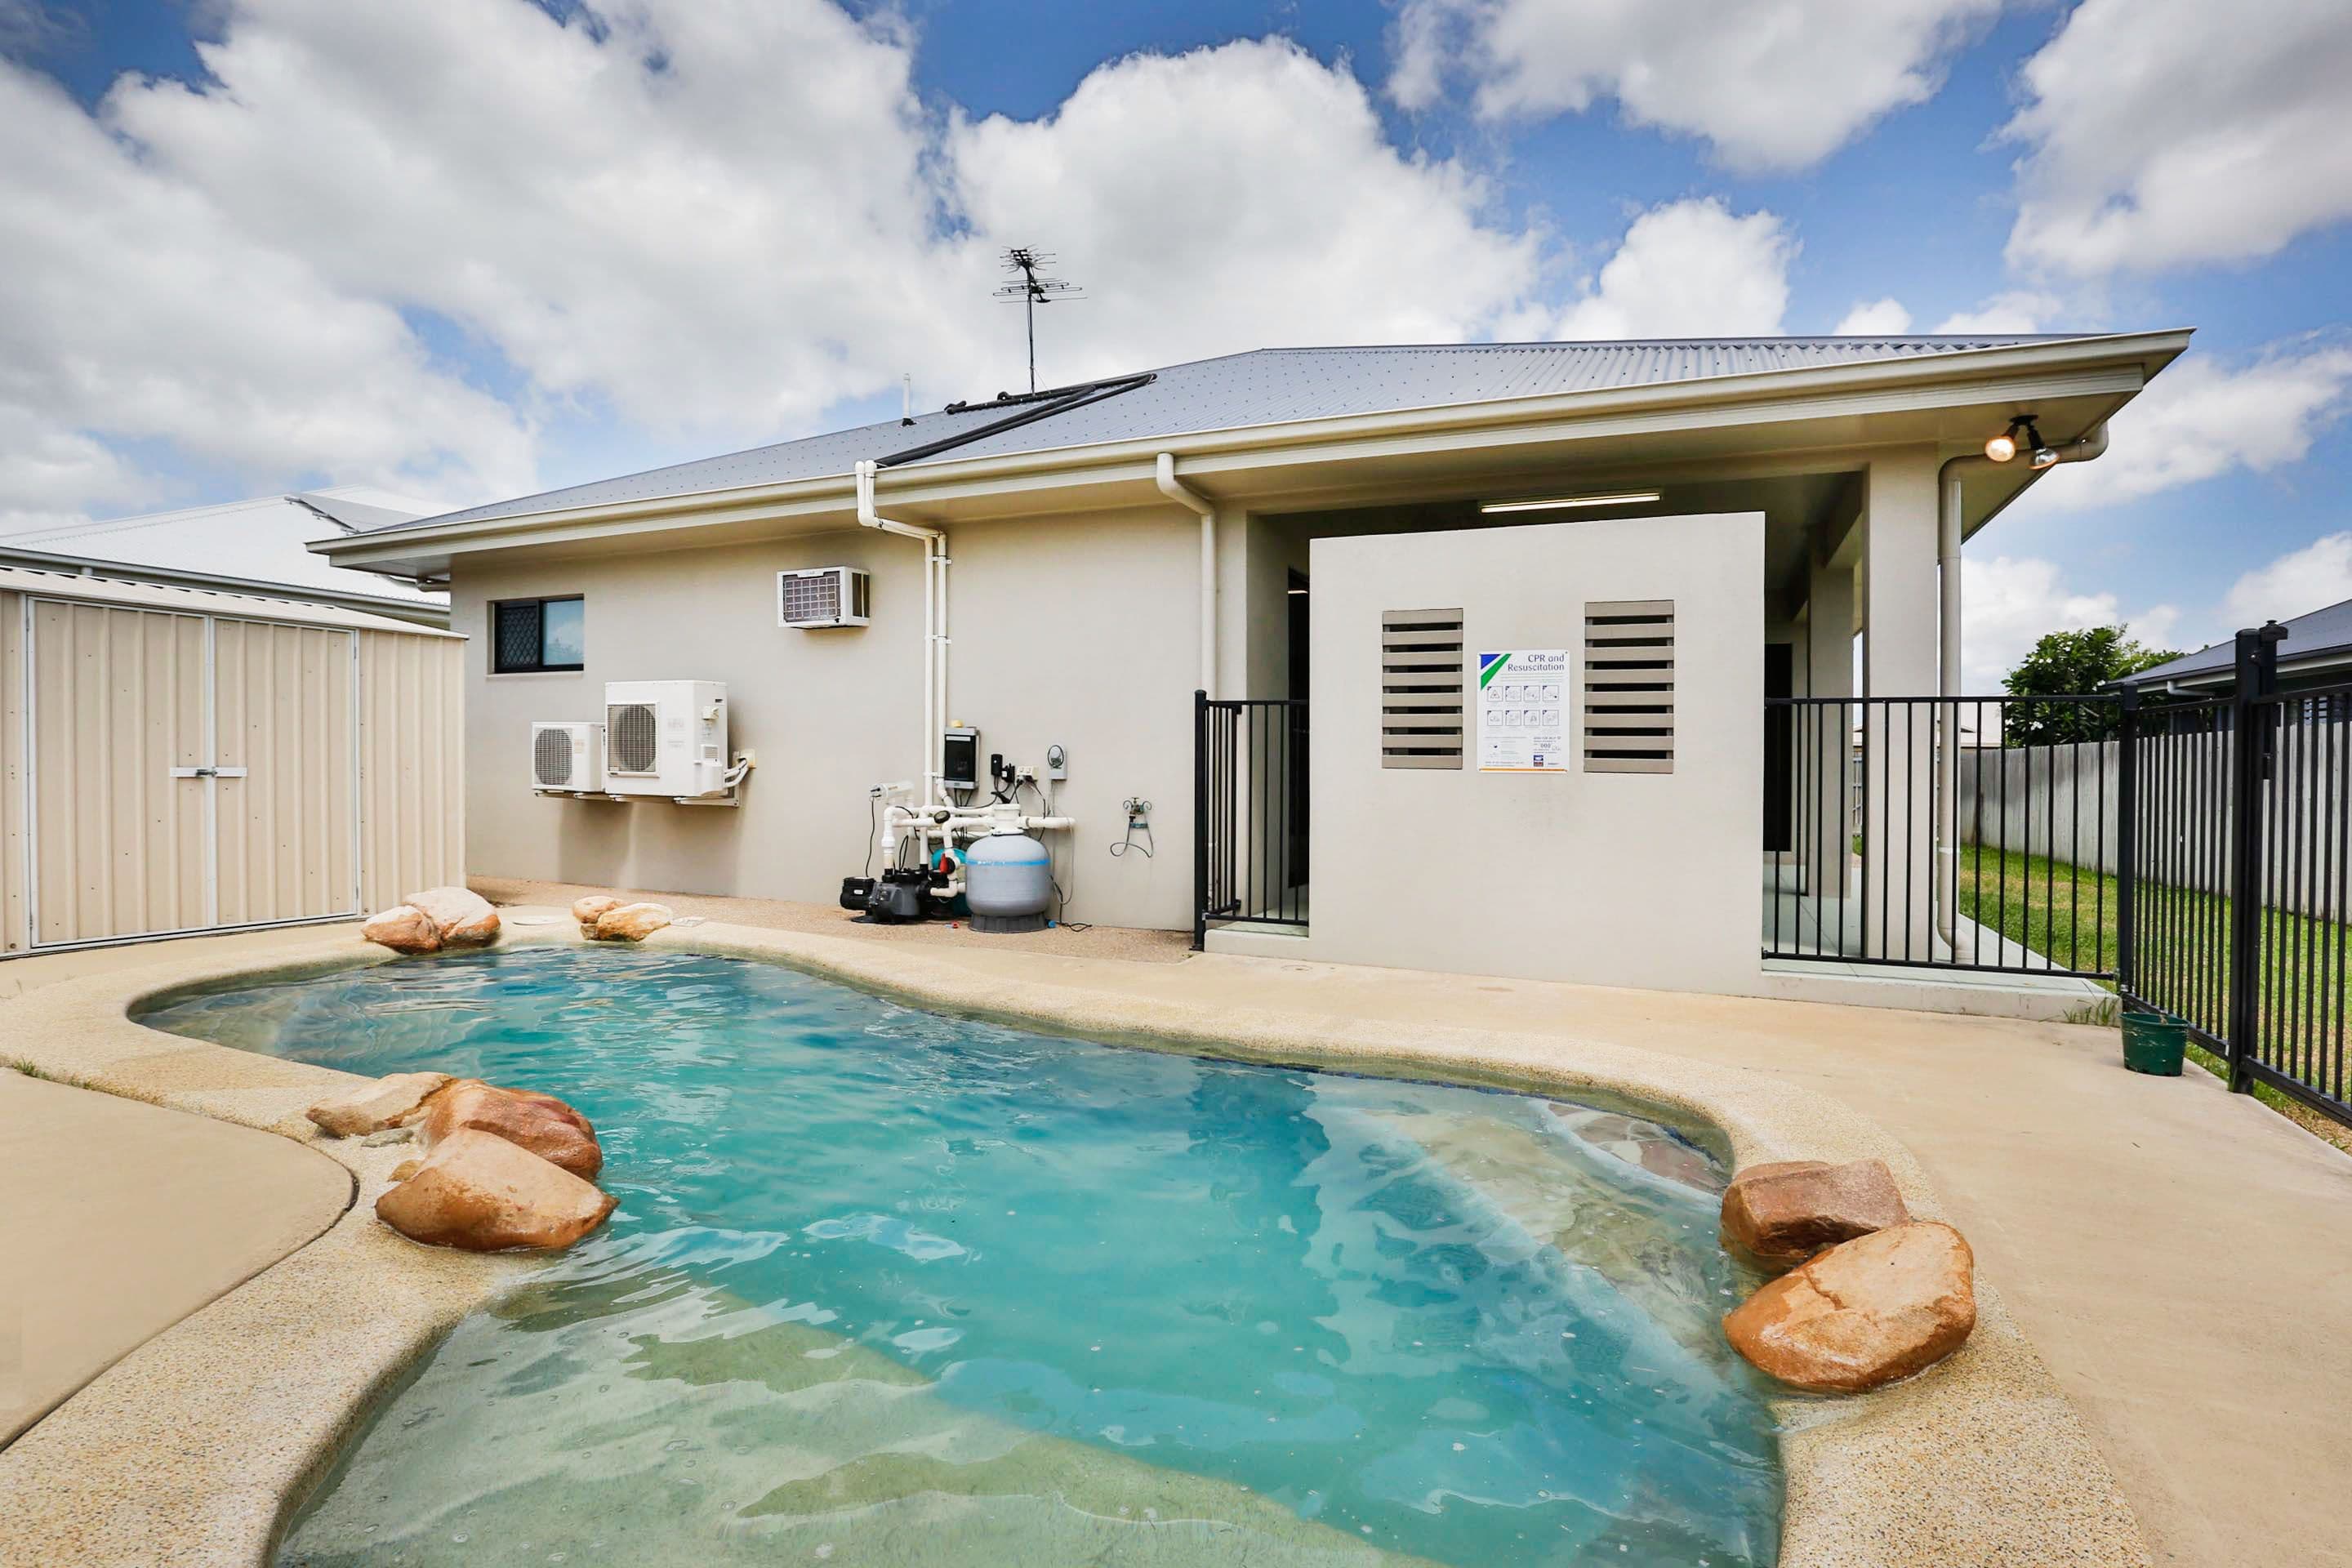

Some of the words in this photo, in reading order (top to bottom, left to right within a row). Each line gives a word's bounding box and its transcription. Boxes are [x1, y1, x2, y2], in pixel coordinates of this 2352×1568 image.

[1528, 654, 1545, 662] CPR
[1548, 653, 1564, 662] and
[1508, 663, 1565, 671] Resuscitation
